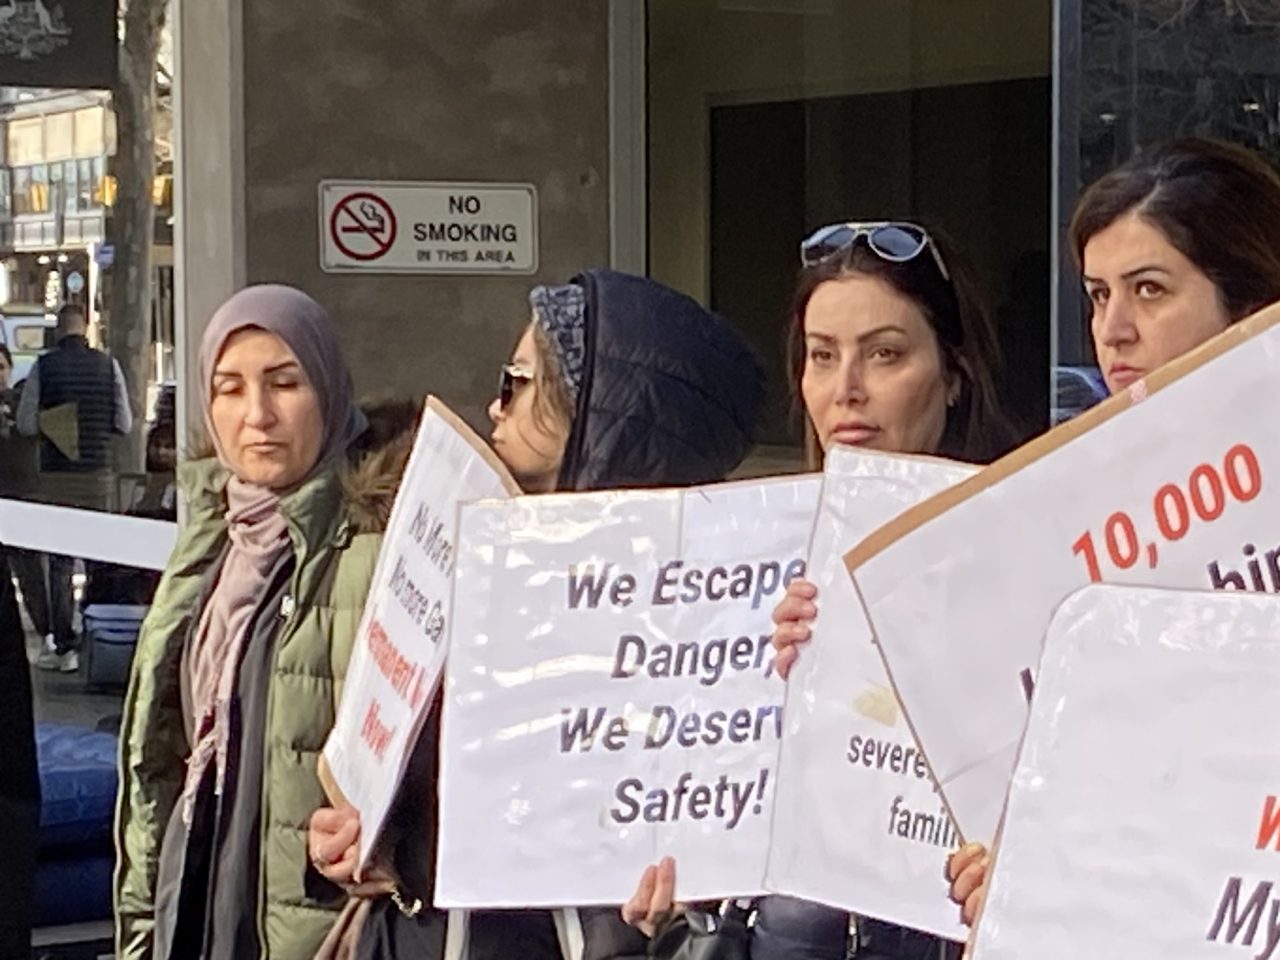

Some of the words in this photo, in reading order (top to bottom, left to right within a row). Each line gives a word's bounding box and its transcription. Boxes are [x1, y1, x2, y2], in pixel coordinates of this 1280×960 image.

[448, 195, 481, 214] NO
[413, 222, 518, 243] SMOKING
[417, 250, 431, 262] IN
[437, 250, 468, 262] THIS
[474, 251, 516, 263] AREA
[1072, 443, 1263, 583] 10,000
[567, 562, 637, 609] We
[560, 707, 630, 754] We
[610, 768, 769, 830] Safety!
